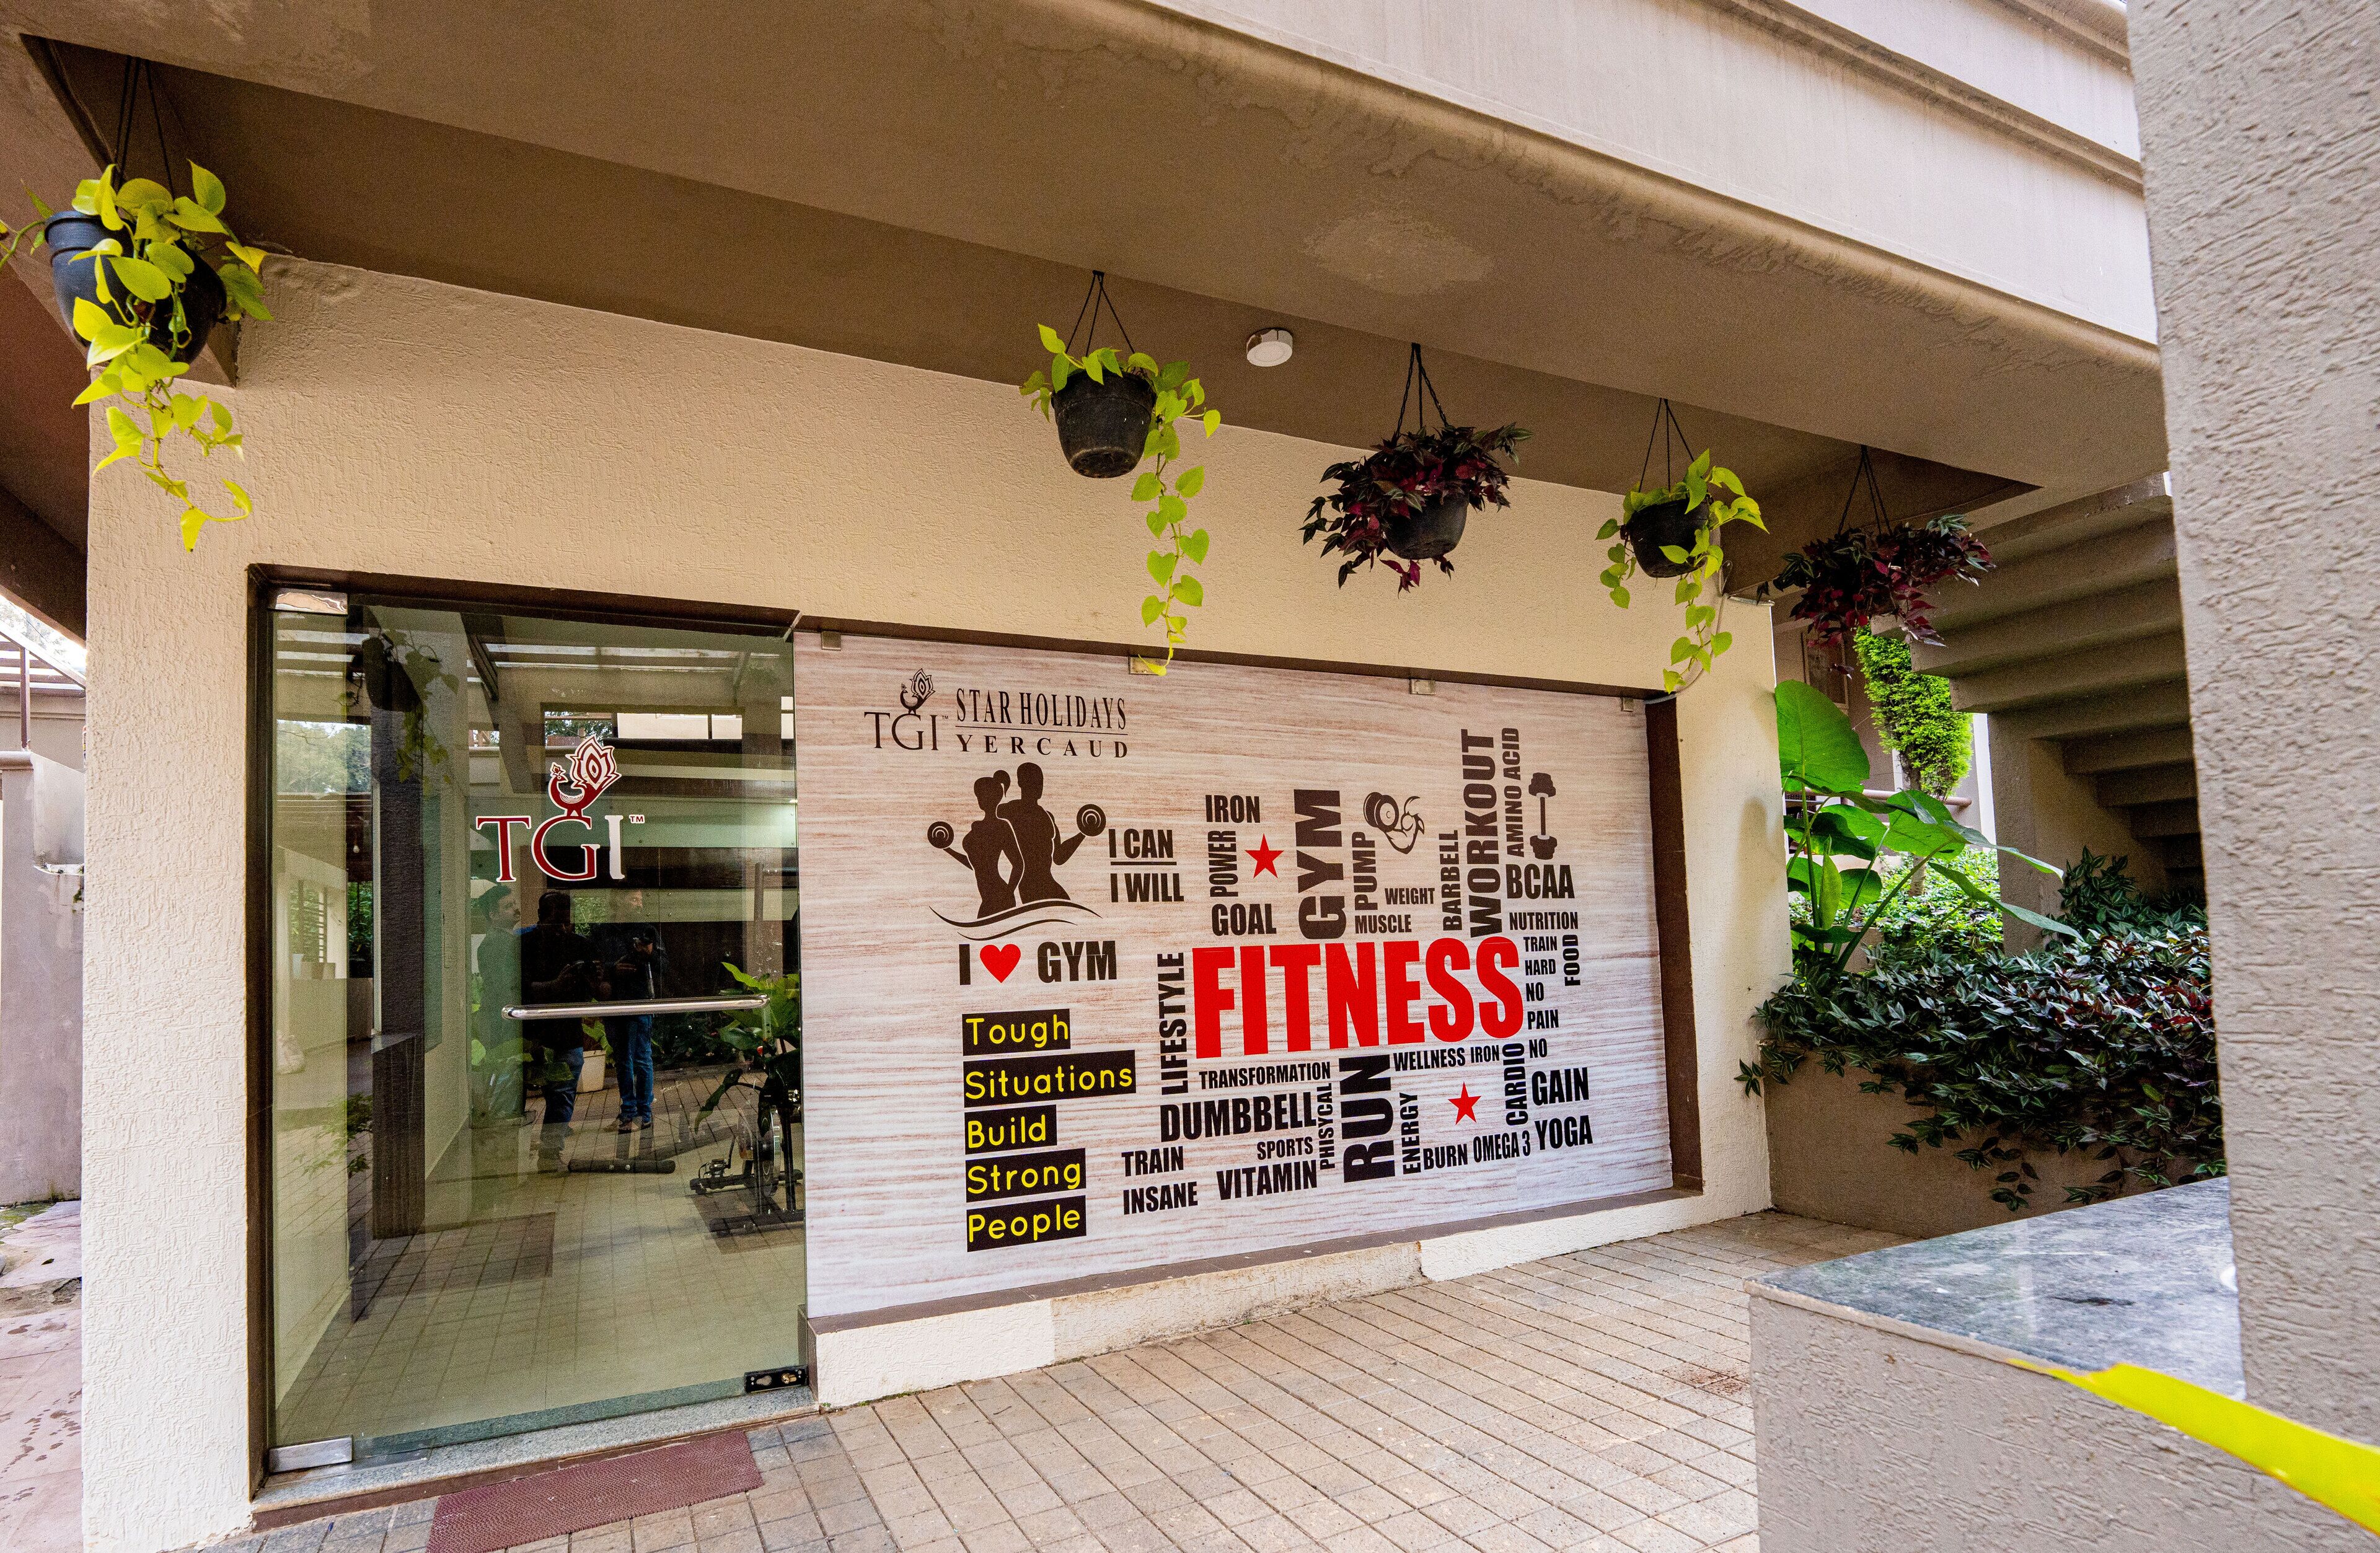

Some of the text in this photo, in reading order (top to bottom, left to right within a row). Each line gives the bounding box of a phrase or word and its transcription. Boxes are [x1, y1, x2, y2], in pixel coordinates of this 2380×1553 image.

[956, 734, 1127, 757] YERCAUD
[1205, 795, 1260, 823] IRON
[1502, 728, 1524, 857] AMINO ACID
[1109, 829, 1173, 858] I CAN
[1461, 729, 1502, 938] WORKOUT
[1208, 831, 1238, 897] POWER
[1294, 789, 1346, 939] GYM
[1352, 832, 1378, 910] PUMP
[1439, 830, 1462, 931] BARBELL
[1111, 873, 1184, 902] I WILL
[1385, 888, 1435, 904] WEIGHT
[1505, 864, 1575, 899] BCAA
[1212, 904, 1276, 936] GOAL
[1355, 915, 1411, 933] MUSCLE
[1509, 912, 1578, 930] NUTRITION
[1523, 936, 1557, 952] TRAIN
[1562, 935, 1580, 986] FOOD
[959, 941, 1117, 985] I GYM
[1525, 959, 1556, 975] HARD
[1192, 936, 1523, 1058] FITNESS
[1526, 982, 1544, 1001] NO
[966, 1014, 1068, 1048] Tough
[1157, 952, 1188, 1095] LIFESTYLE
[1527, 1010, 1559, 1029] PAIN
[1393, 1045, 1499, 1071] WELLNESS IRON
[1529, 1039, 1547, 1058] NO
[966, 1065, 1132, 1099] Situations
[1199, 1062, 1331, 1091] TRANSFORMATION
[1502, 1044, 1528, 1125] CARDIO
[1532, 1067, 1589, 1106] GAIN
[968, 1114, 1046, 1148] Build
[1160, 1092, 1316, 1142] DUMBBELL
[1317, 1083, 1335, 1170] PHISYCAL
[1339, 1054, 1395, 1183] RUN
[1399, 1093, 1421, 1174] ENERGY
[1535, 1115, 1593, 1150] YOGA
[1121, 1146, 1183, 1177] TRAIN
[1257, 1137, 1313, 1160] SPORTS
[1423, 1144, 1468, 1169] BURN
[1473, 1130, 1530, 1163] OMEGA 3
[967, 1163, 1080, 1194] Strong
[1217, 1159, 1317, 1200] VITAMIN
[1124, 1182, 1197, 1215] INSANE
[969, 1204, 1080, 1243] People
